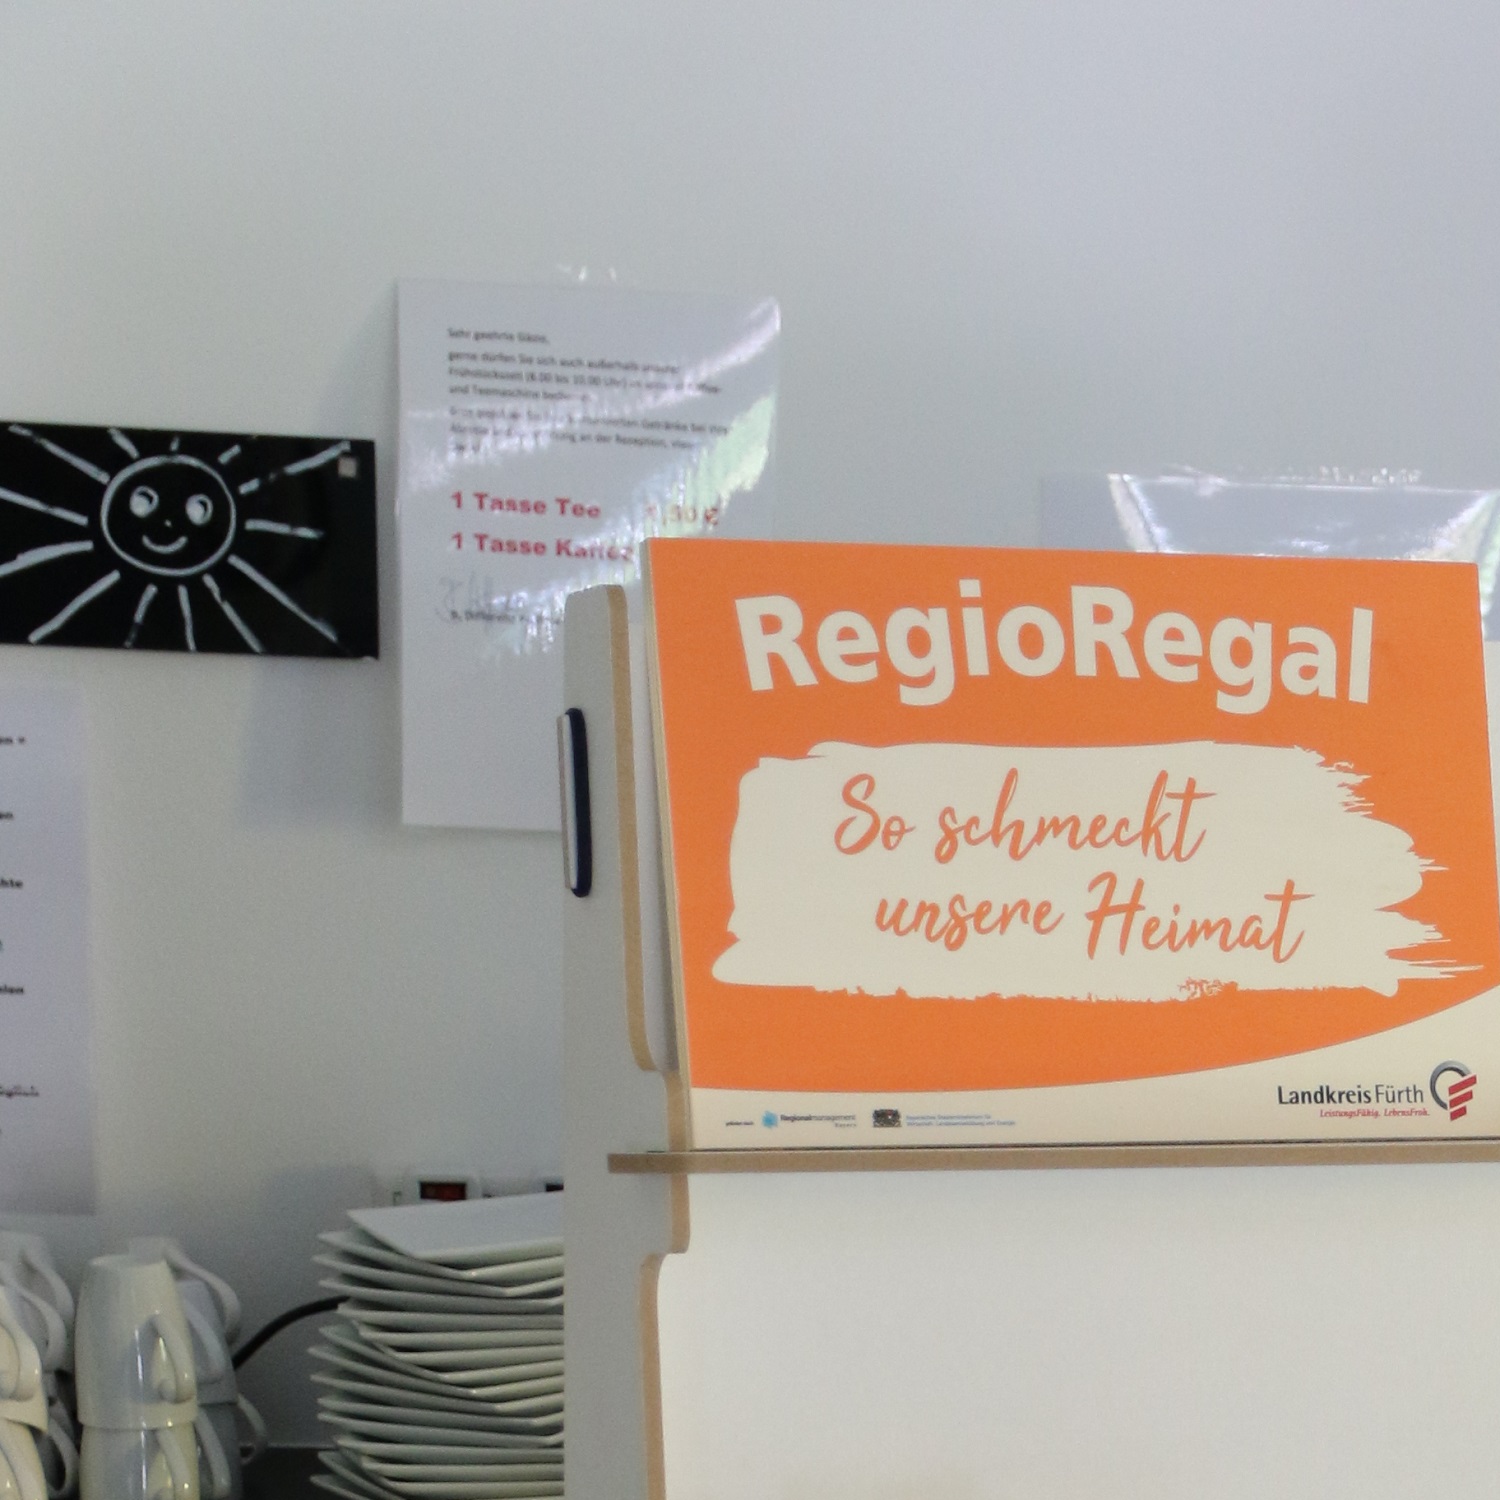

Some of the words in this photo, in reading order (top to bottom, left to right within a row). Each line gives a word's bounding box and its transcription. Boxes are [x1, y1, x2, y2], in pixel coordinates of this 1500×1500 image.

[452, 491, 462, 510] 1
[473, 492, 547, 516] Tasse
[555, 498, 602, 519] Tee
[452, 532, 463, 550] 1
[473, 533, 547, 557] Tasse
[734, 578, 1375, 716] RegioRegal
[834, 772, 914, 856] So
[933, 766, 1217, 865] schmeckt
[875, 891, 1064, 955] unsere
[1081, 870, 1315, 964] Heimat
[1278, 1085, 1371, 1105] Landkreis
[1374, 1083, 1424, 1104] Fürth
